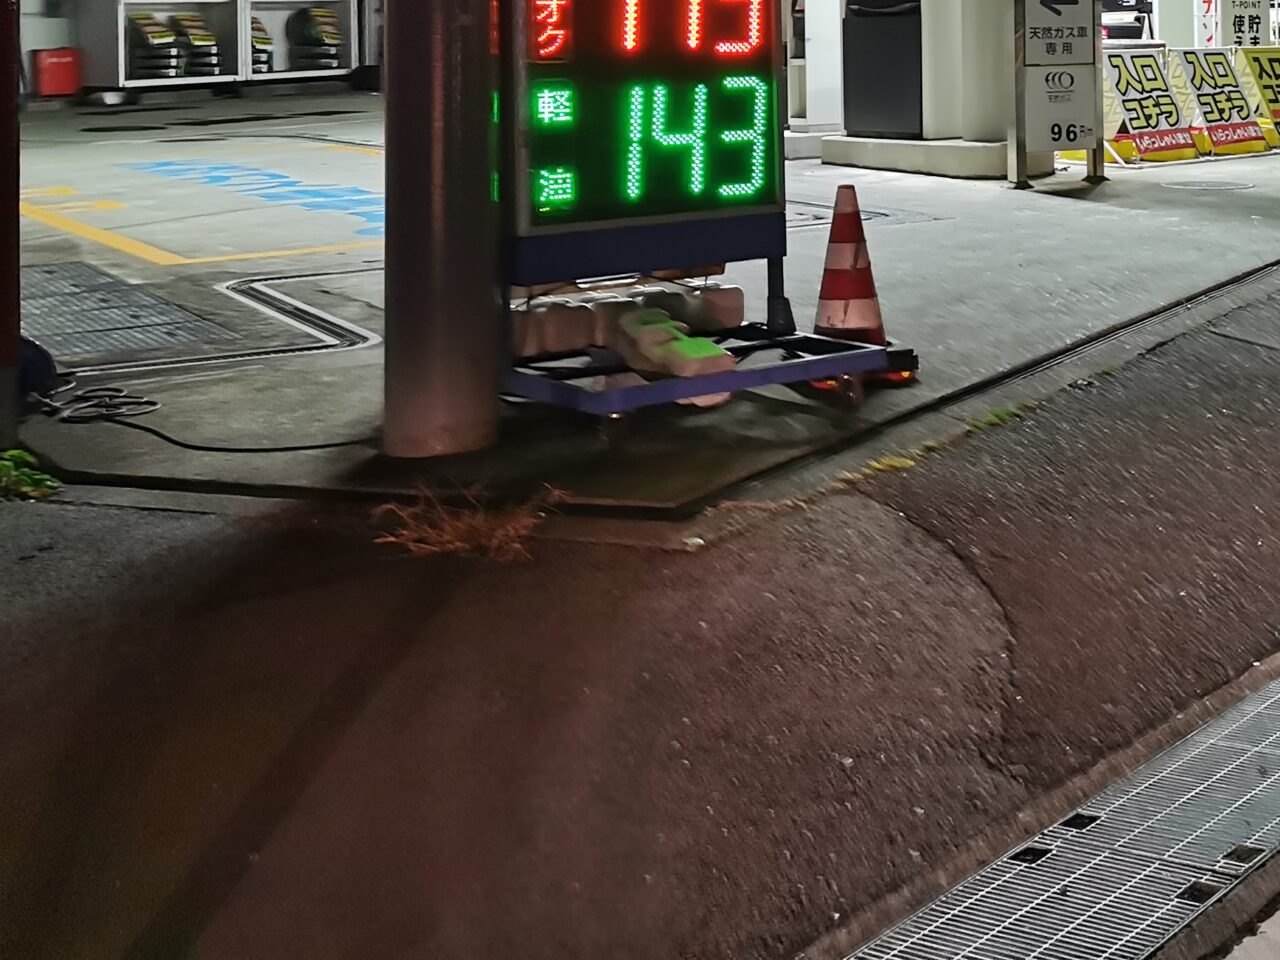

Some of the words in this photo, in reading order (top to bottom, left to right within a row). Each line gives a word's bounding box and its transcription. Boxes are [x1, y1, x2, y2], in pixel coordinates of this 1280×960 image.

[1231, 0, 1261, 9] T-POINT
[1029, 26, 1088, 40] 天然ガス車
[1045, 42, 1073, 55] 専用
[1108, 53, 1170, 97] 入口
[1183, 51, 1240, 90] 入口
[1122, 93, 1180, 130] コチラ
[1197, 89, 1251, 123] コチラ
[536, 89, 574, 202] 軽油
[626, 76, 768, 199] 143
[1050, 122, 1078, 142] 96
[1136, 130, 1192, 151] いらっしゃいませ
[1211, 125, 1263, 142] いらっしゃいませ
